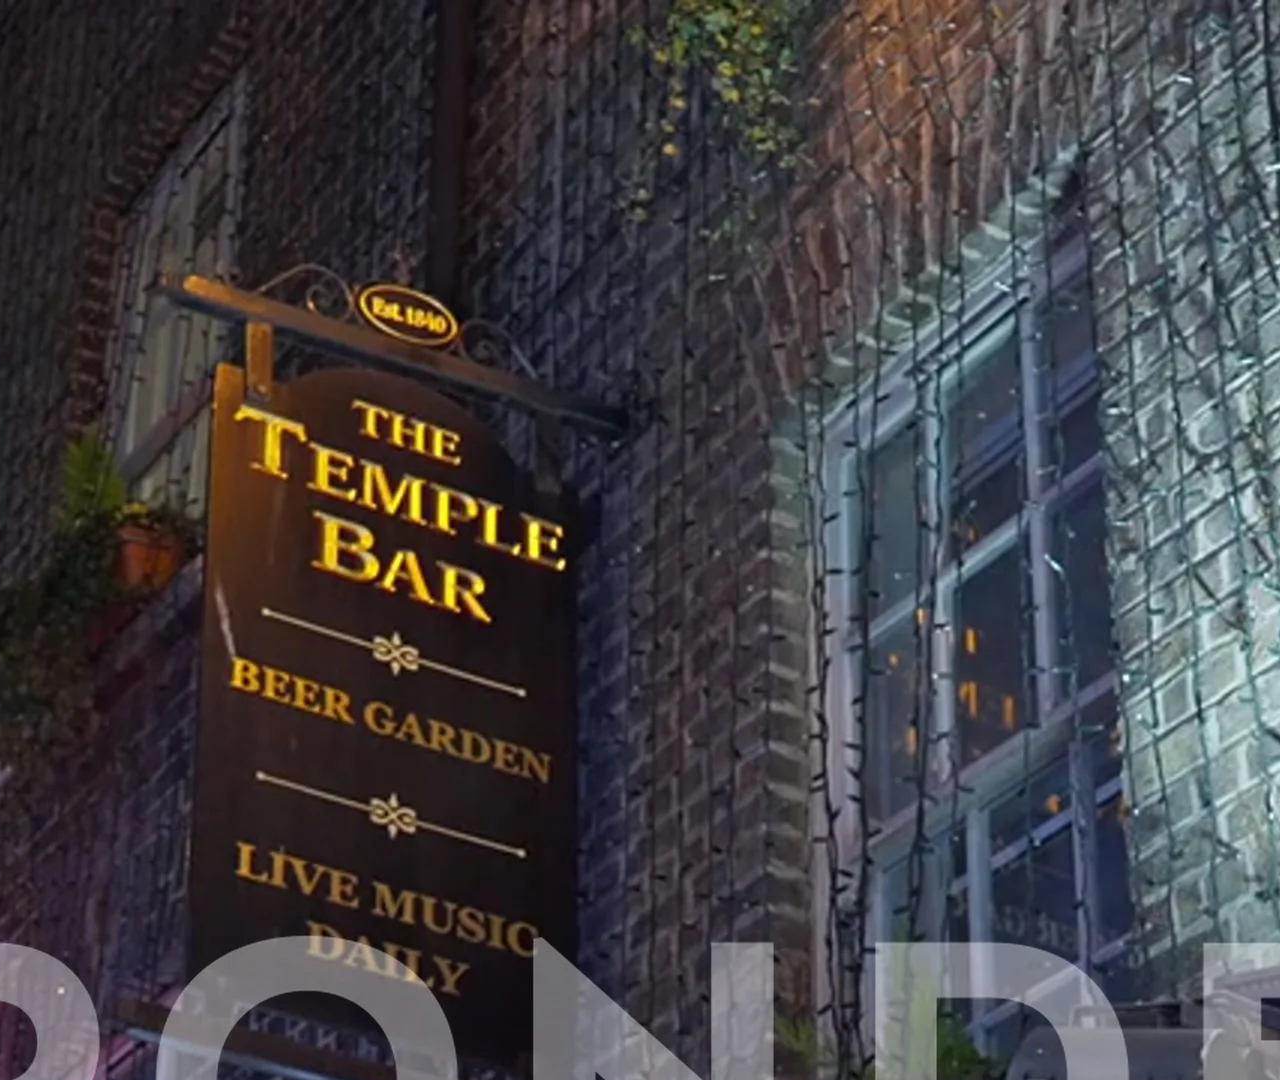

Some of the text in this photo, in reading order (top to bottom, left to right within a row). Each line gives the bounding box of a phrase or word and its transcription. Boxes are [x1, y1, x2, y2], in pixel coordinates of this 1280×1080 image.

[405, 306, 447, 334] 1840
[234, 404, 567, 572] TEMPLE
[352, 399, 462, 466] THE
[312, 511, 492, 623] BAR
[231, 657, 552, 783] BEER GARDEN
[235, 841, 539, 958] LIVE MUSIC
[306, 920, 470, 996] DAILY
